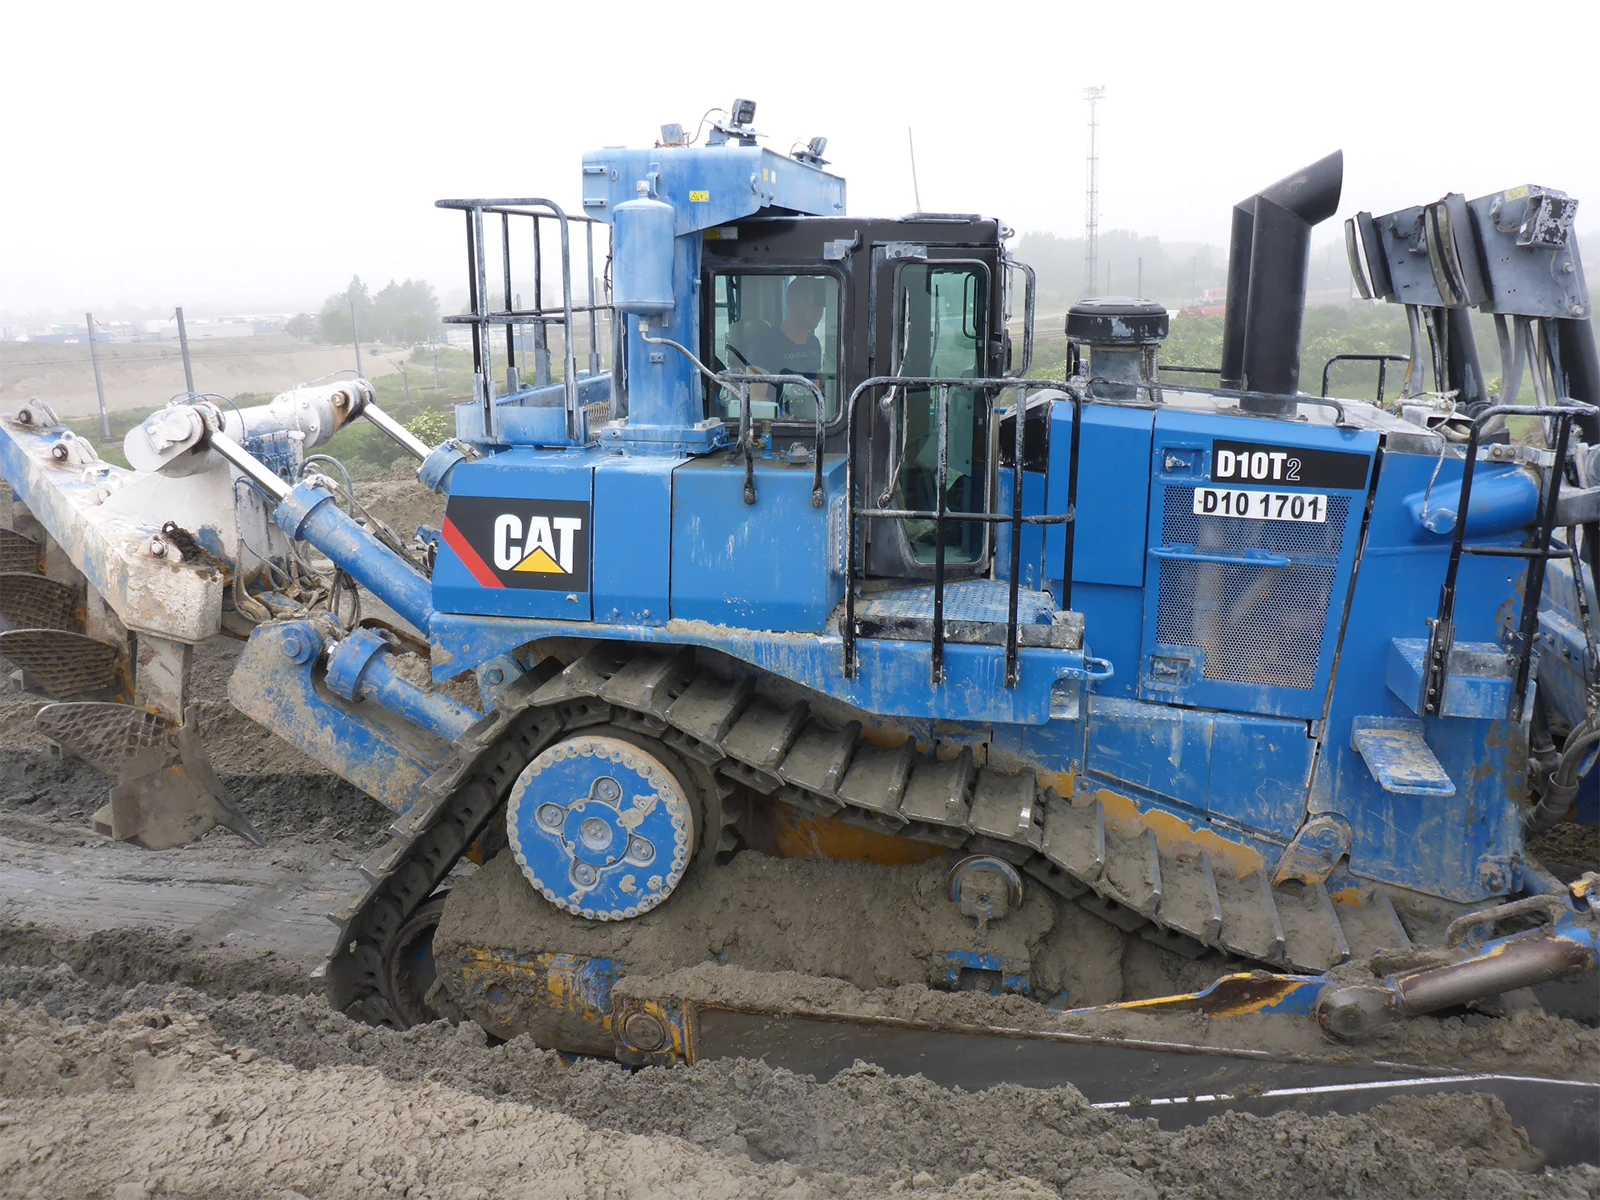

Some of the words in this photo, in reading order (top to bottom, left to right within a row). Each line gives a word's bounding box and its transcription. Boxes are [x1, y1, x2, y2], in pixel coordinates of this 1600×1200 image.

[1216, 450, 1301, 481] D10T2
[1202, 490, 1249, 516] D10
[1259, 493, 1319, 521] 1701
[493, 513, 582, 575] CAT
